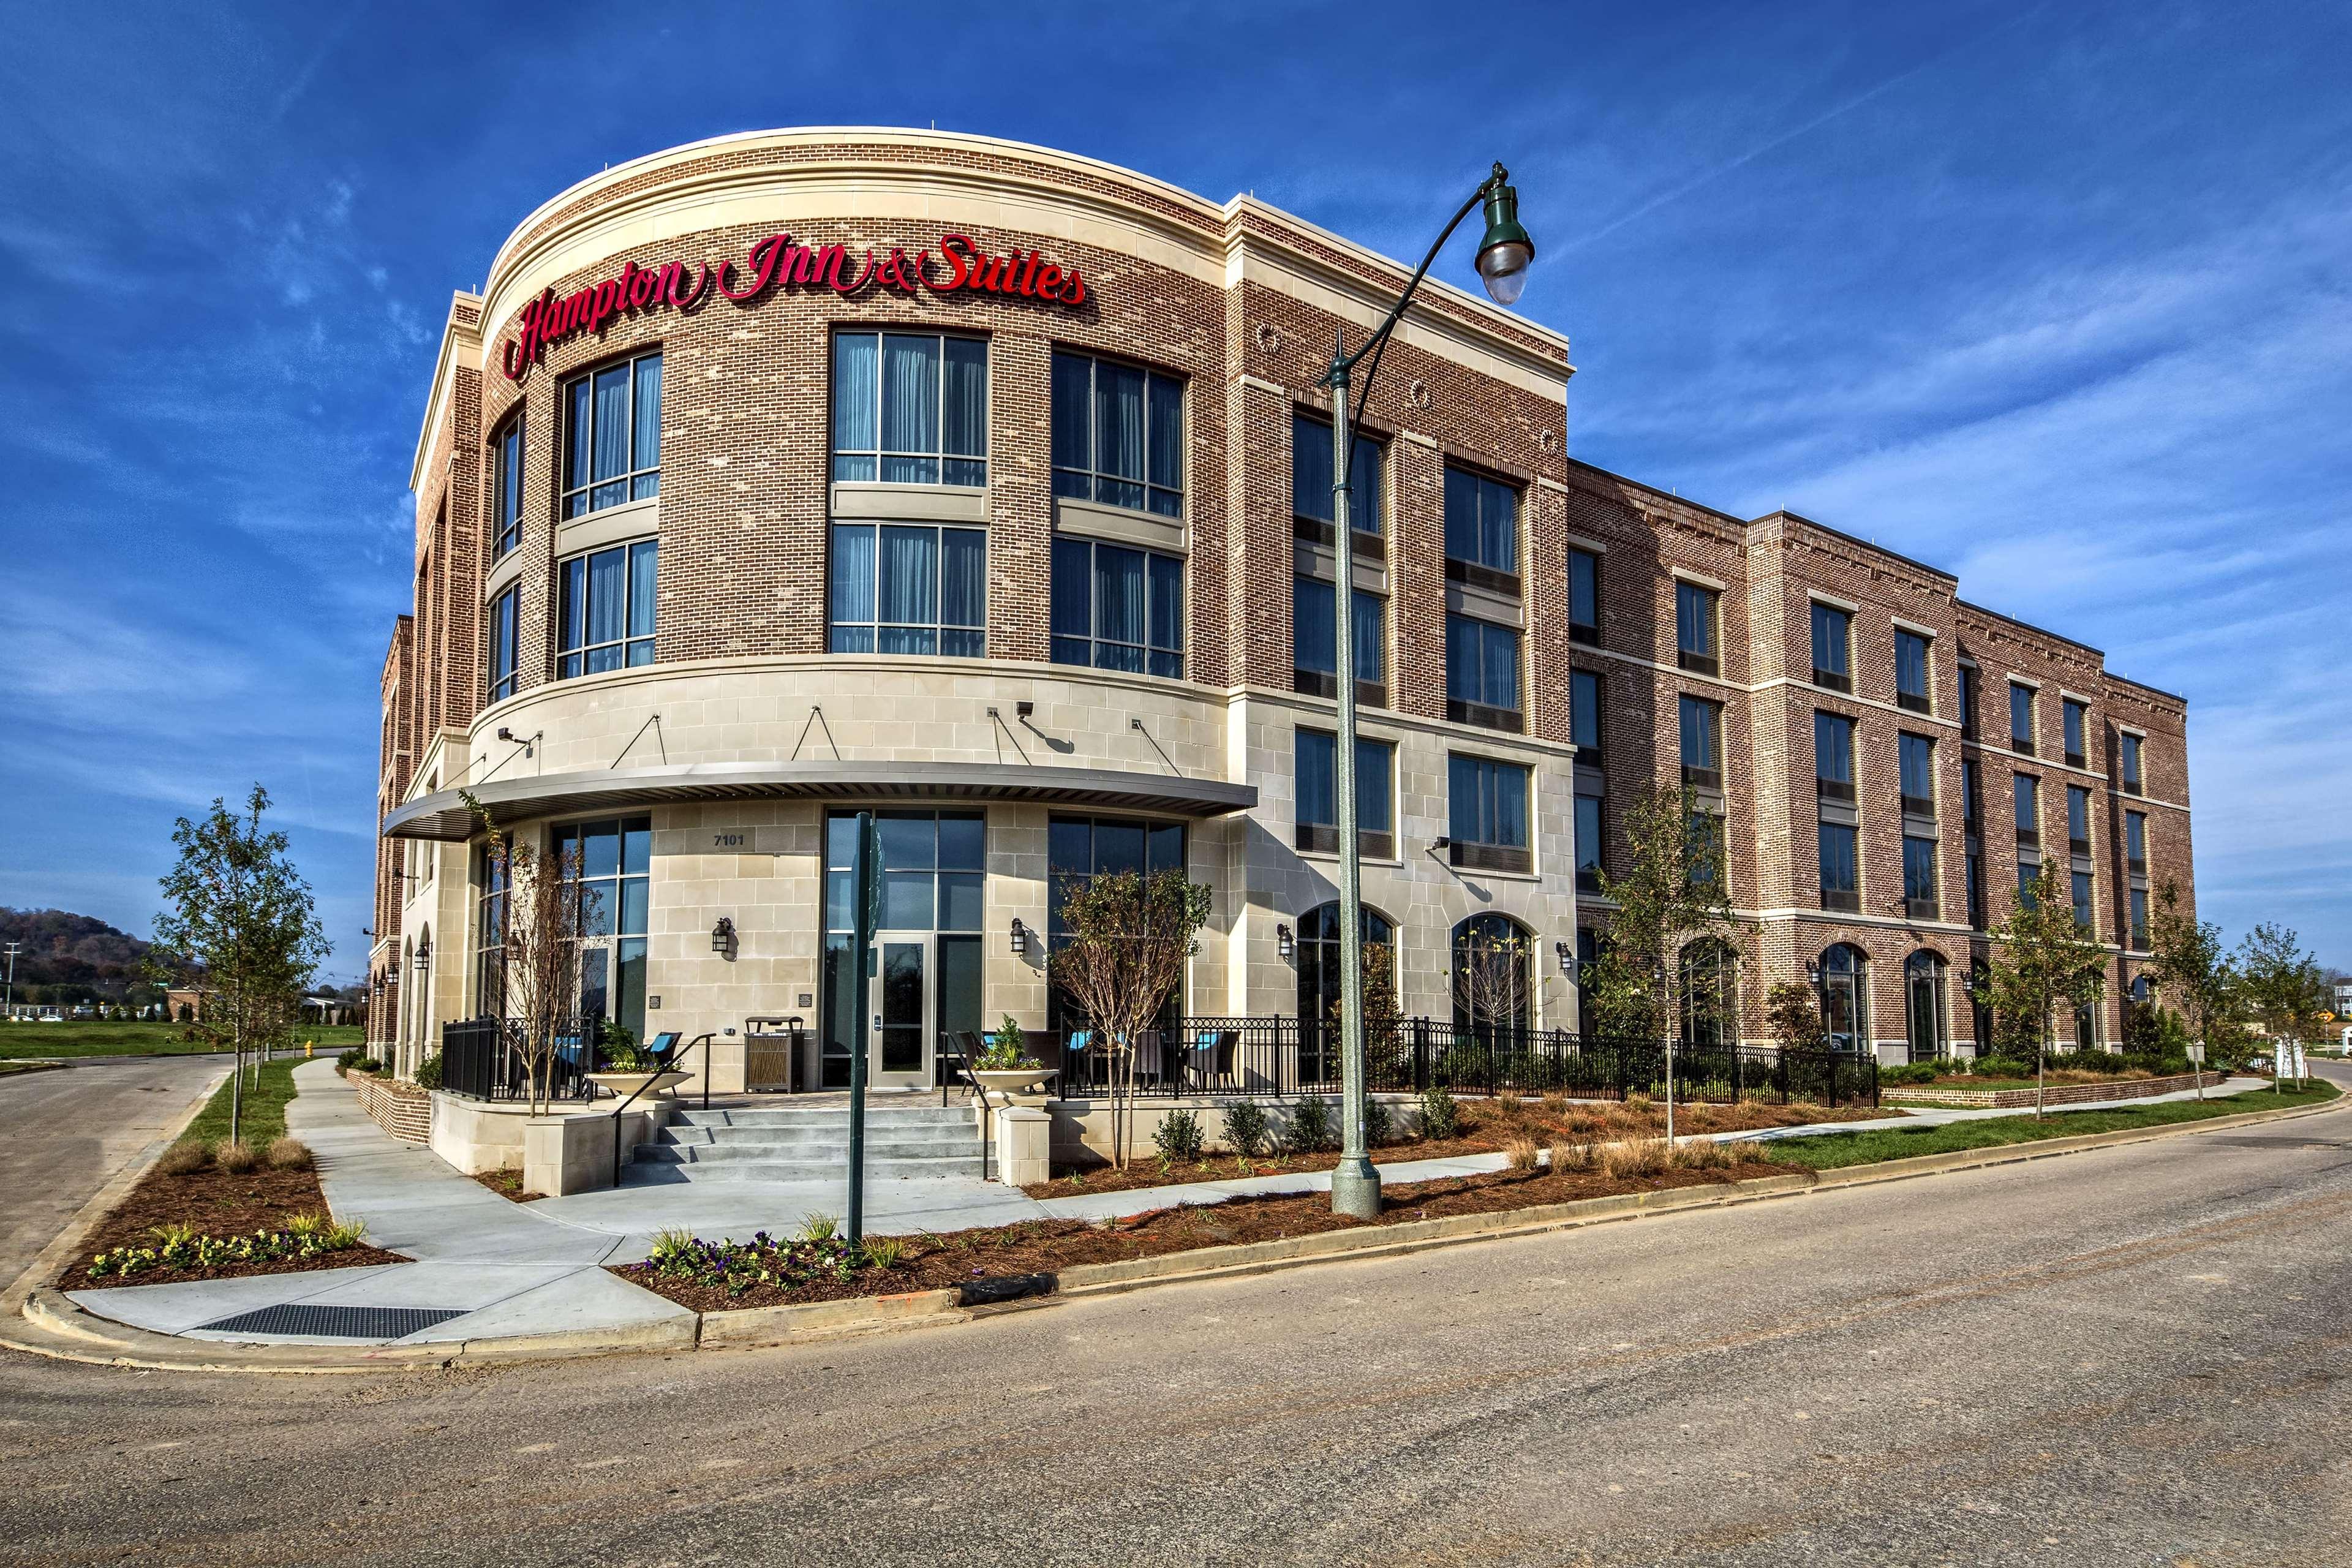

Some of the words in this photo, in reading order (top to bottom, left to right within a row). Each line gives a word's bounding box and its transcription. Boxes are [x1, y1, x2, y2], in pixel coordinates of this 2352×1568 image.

[502, 260, 709, 380] Hampton
[716, 233, 873, 300] Inn
[875, 247, 917, 291] &
[915, 234, 1086, 305] Suites
[714, 834, 744, 846] 7101
